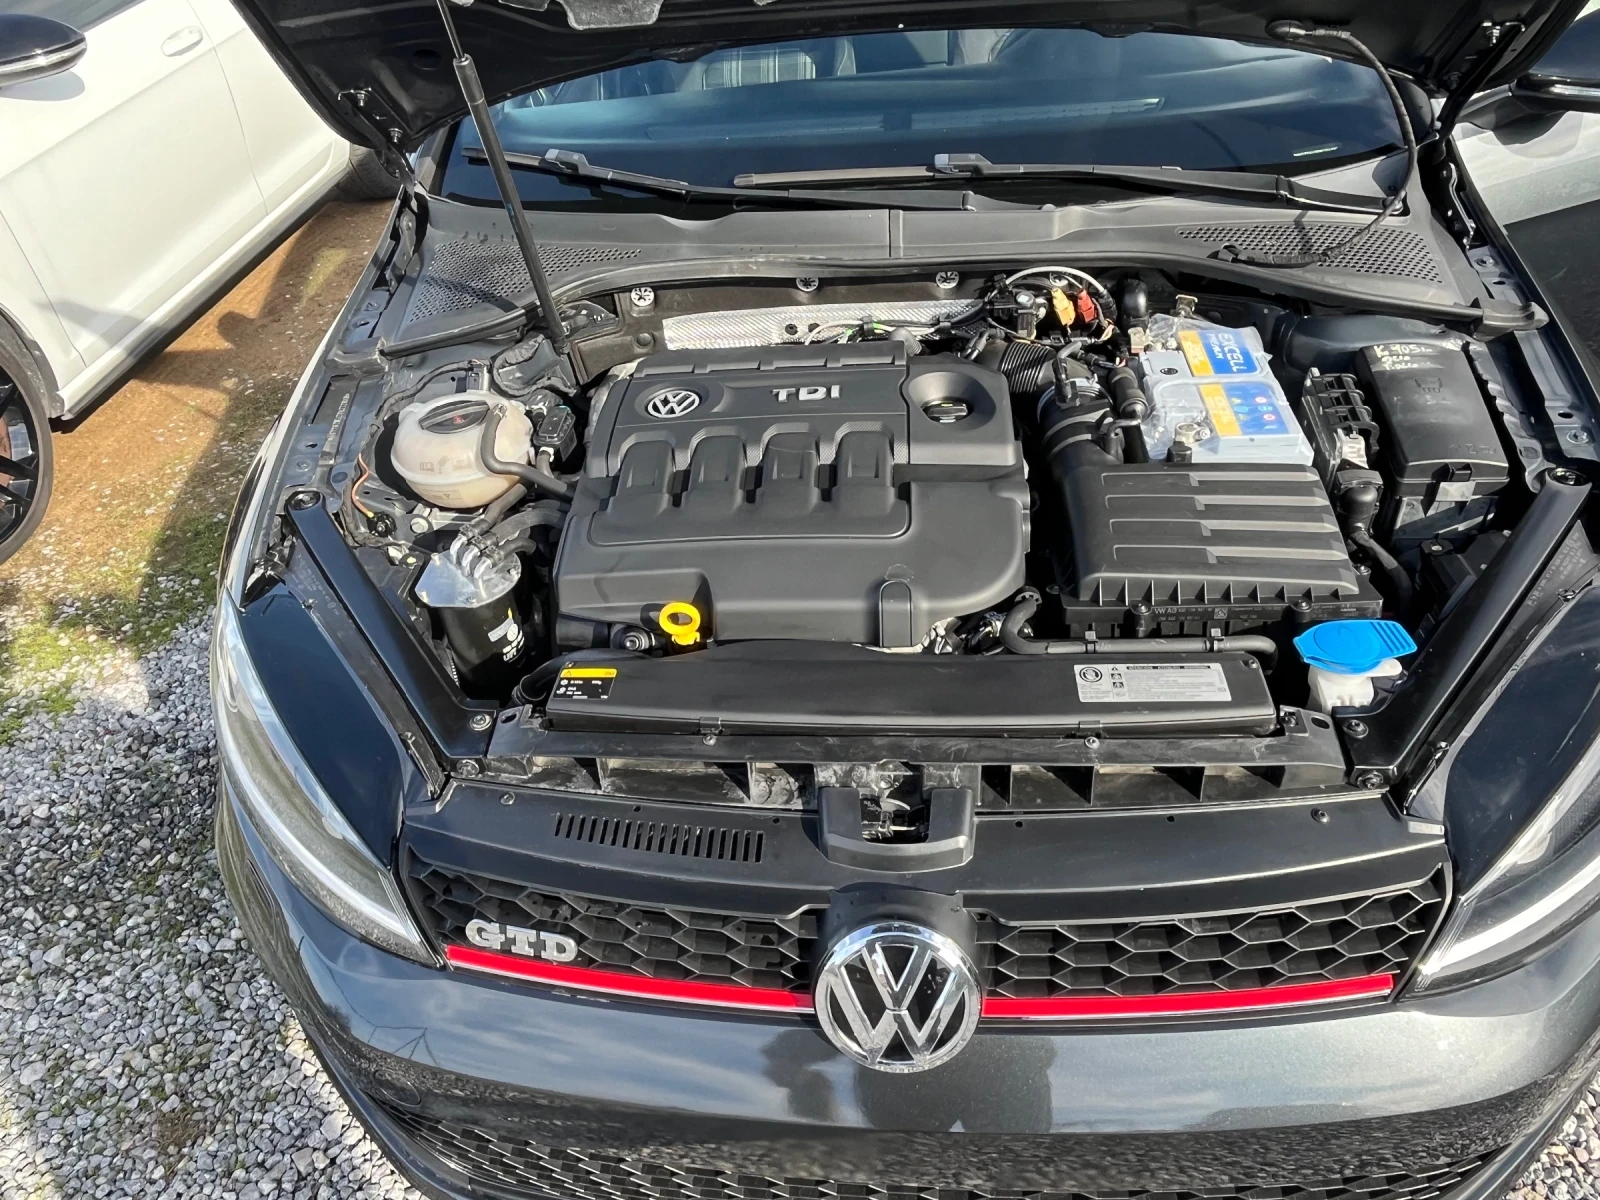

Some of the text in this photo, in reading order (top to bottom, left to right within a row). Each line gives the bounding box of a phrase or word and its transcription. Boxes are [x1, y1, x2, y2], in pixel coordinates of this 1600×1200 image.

[1218, 332, 1247, 373] EXCELL
[771, 384, 840, 402] TDI
[465, 918, 578, 962] GTD
